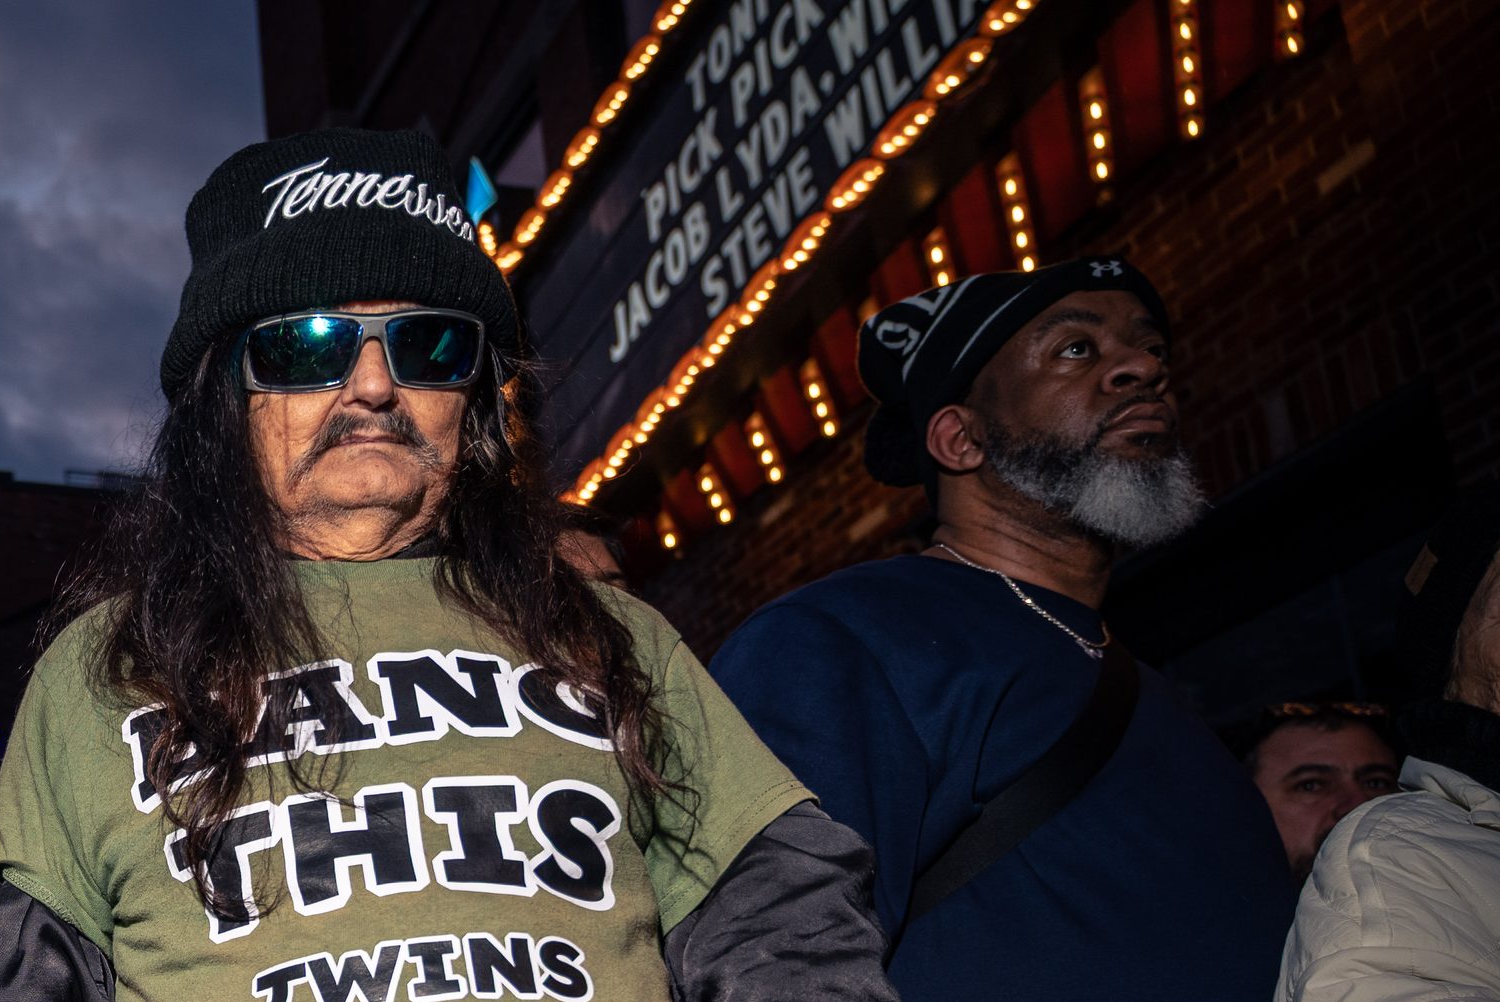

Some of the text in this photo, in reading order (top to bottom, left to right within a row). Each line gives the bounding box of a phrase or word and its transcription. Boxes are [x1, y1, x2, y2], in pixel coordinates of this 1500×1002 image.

[643, 104, 724, 244] PICK
[700, 145, 819, 319] STEVE
[609, 201, 711, 363] JACOB
[163, 775, 622, 943] THIS
